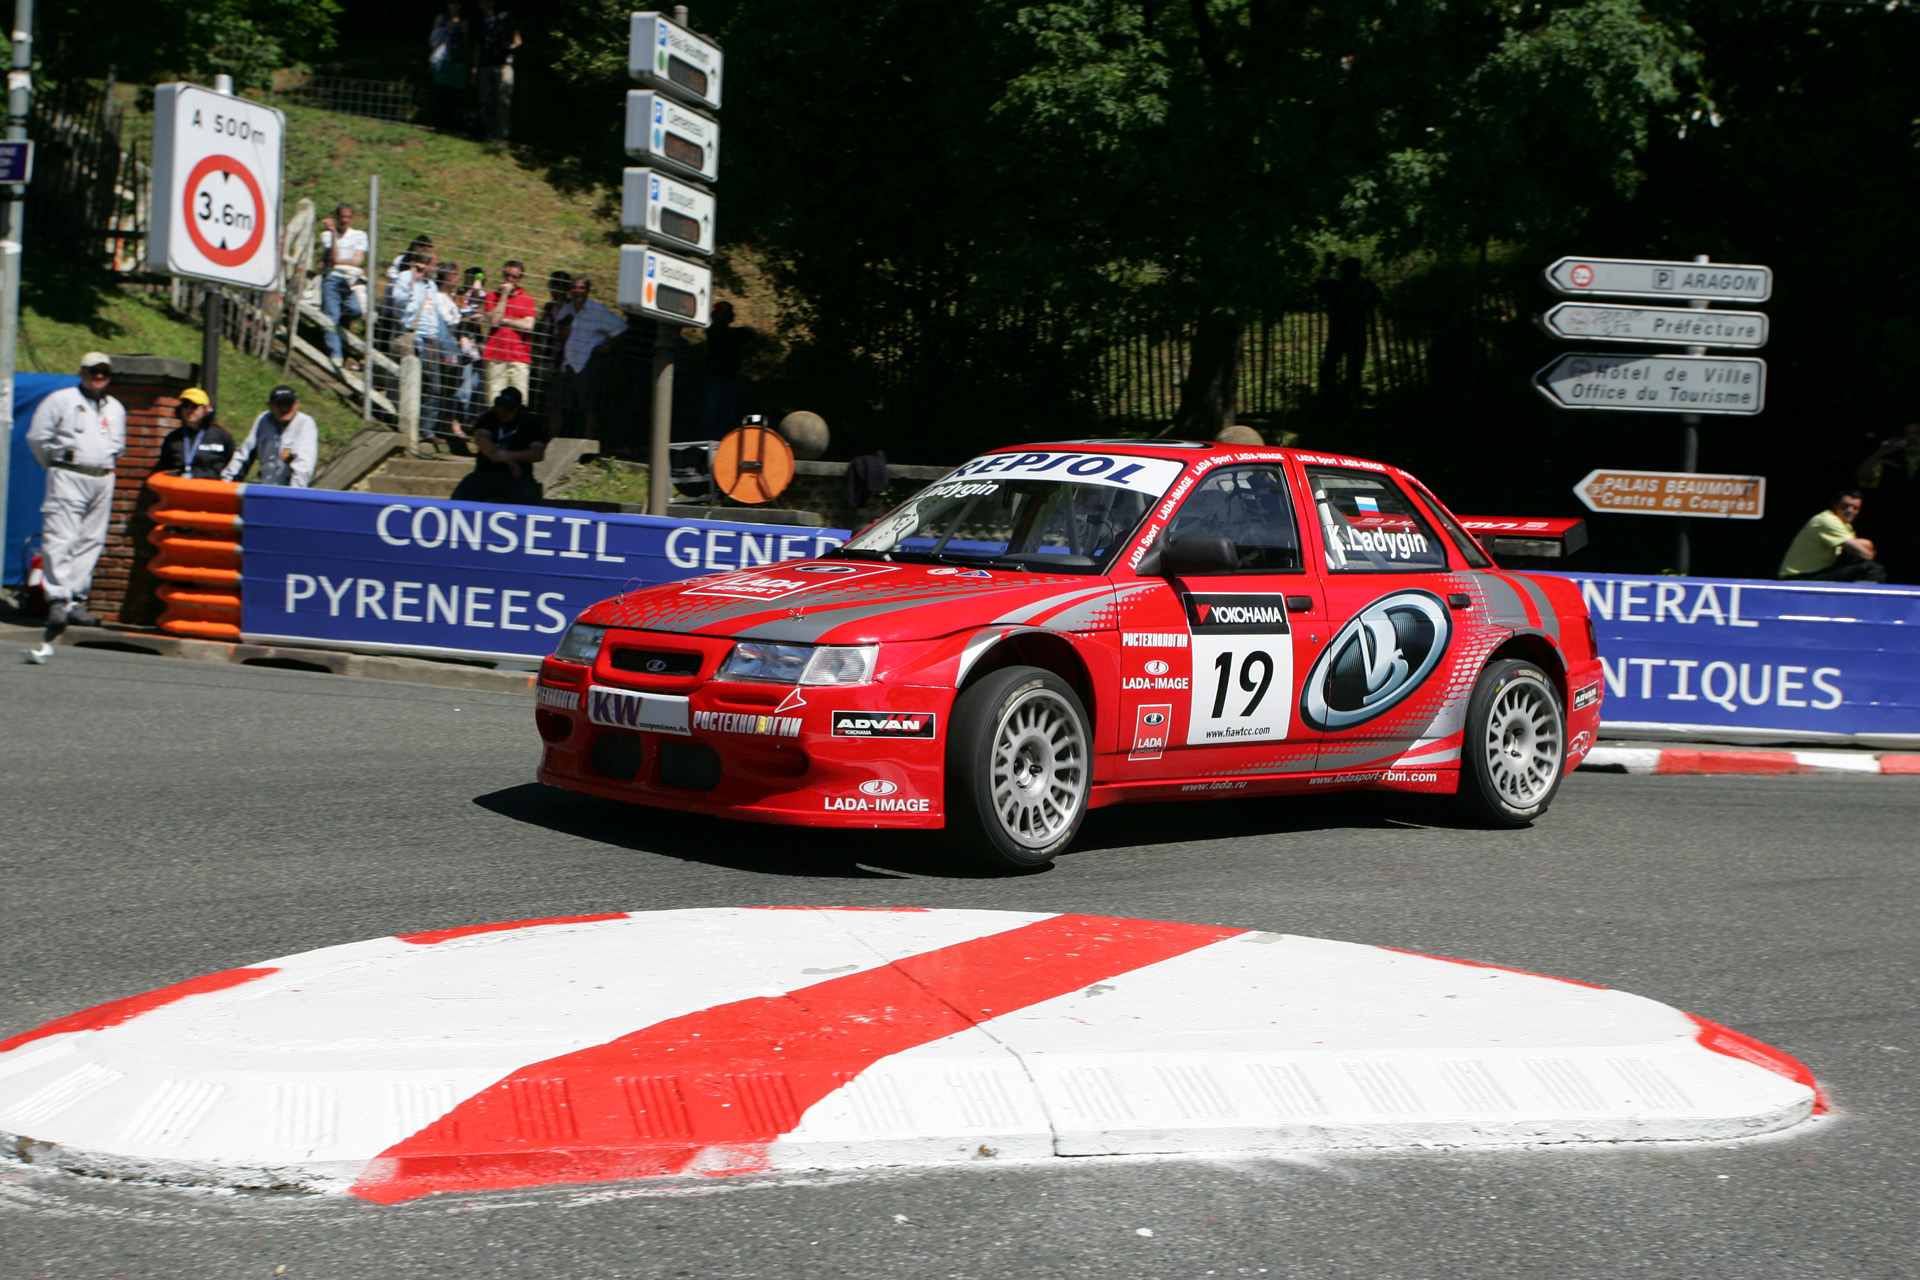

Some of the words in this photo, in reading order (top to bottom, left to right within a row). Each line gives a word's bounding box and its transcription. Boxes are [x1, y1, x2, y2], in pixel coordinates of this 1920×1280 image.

[192, 109, 203, 128] A
[214, 114, 265, 144] 500m
[197, 191, 252, 230] 3.6m
[1681, 273, 1760, 292] ARAGON
[1653, 318, 1757, 338] Préfecture
[1595, 363, 1650, 381] Hôtel
[1664, 367, 1687, 382] de
[1704, 368, 1753, 384] Ville
[1571, 383, 1627, 400] Office
[1636, 386, 1659, 401] du
[1669, 386, 1752, 404] Tourisme
[1191, 459, 1213, 476] LADA
[1210, 454, 1234, 466] Sport
[1234, 453, 1284, 461] LADA-IMAGE
[1295, 454, 1317, 462] LADA
[1316, 456, 1338, 465] Sport
[1339, 458, 1386, 471] LADA-IMAGE
[941, 454, 1146, 484] REPSOL
[1602, 477, 1660, 493] PALAIS
[1665, 480, 1757, 496] BEAUMONT
[1157, 475, 1195, 521] LADA-IMAGE
[1601, 492, 1656, 507] Centre
[1662, 495, 1681, 508] de
[1689, 496, 1755, 513] Congrès
[376, 504, 626, 563] CONSEIL
[1326, 525, 1428, 559] K.Ladygin
[1127, 546, 1147, 570] LADA
[1141, 524, 1160, 548] Sport
[707, 585, 784, 594] SPORT
[724, 577, 807, 589] LADA
[285, 573, 567, 633] PYRENEES
[1570, 578, 1759, 627] NERAL
[1211, 606, 1283, 623] YOKOHAMA
[1122, 632, 1188, 648] РОСТЕХНОЛОГИИ
[1122, 677, 1189, 690] LADA-IMAGE
[1211, 650, 1274, 719] 19
[1575, 688, 1597, 704] ADVAN
[593, 691, 643, 727] KW
[836, 719, 919, 730] ADVAN
[1205, 726, 1270, 739] www.fiawtcc.com
[1138, 737, 1162, 748] LADA
[1181, 779, 1247, 791] www.lada.ru
[1309, 770, 1437, 785] www.ladasport-rbm.com
[824, 797, 930, 811] LADA-IMAGE
